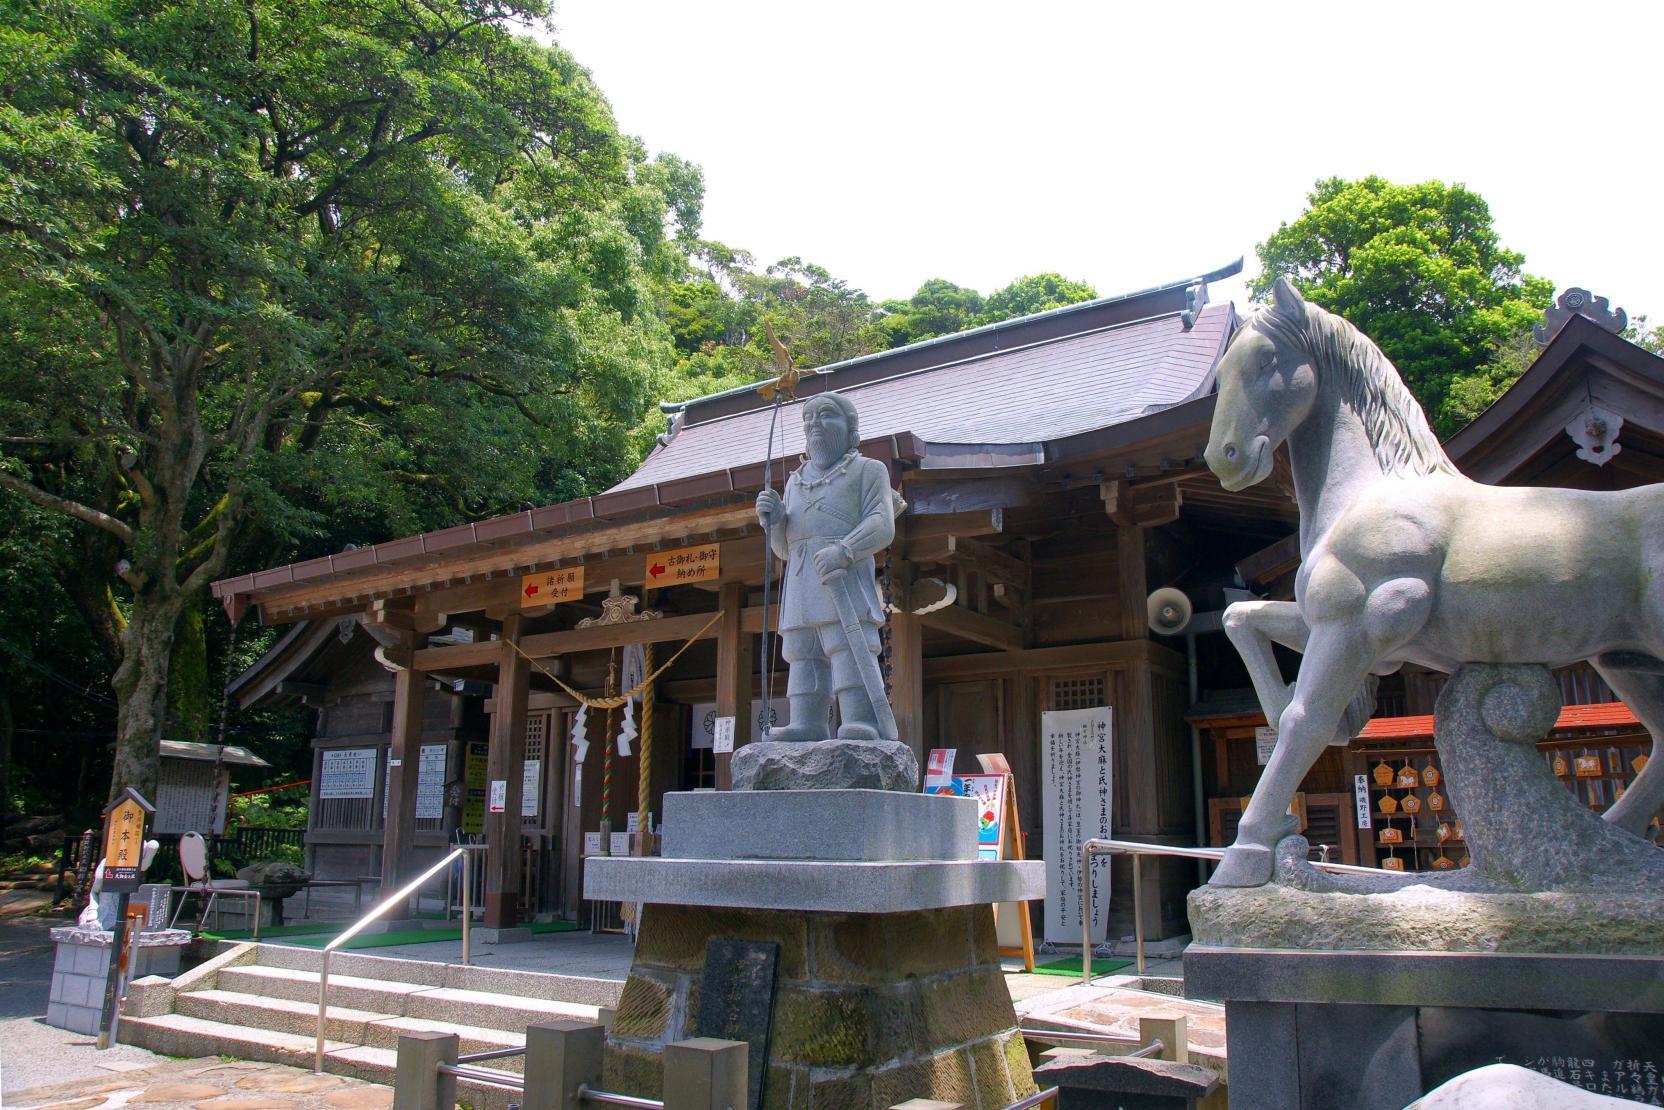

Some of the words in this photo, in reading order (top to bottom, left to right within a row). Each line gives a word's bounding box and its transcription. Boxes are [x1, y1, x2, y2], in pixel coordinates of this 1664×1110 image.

[667, 549, 717, 567] 古御札・御守
[546, 572, 575, 586] 諸祈願
[676, 566, 706, 579] 納め所
[551, 587, 569, 598] 受付
[1357, 776, 1367, 794] 奉納
[1097, 721, 1108, 868] 神宮大麻と氏神さまのおを
[118, 810, 134, 861] 御本殿
